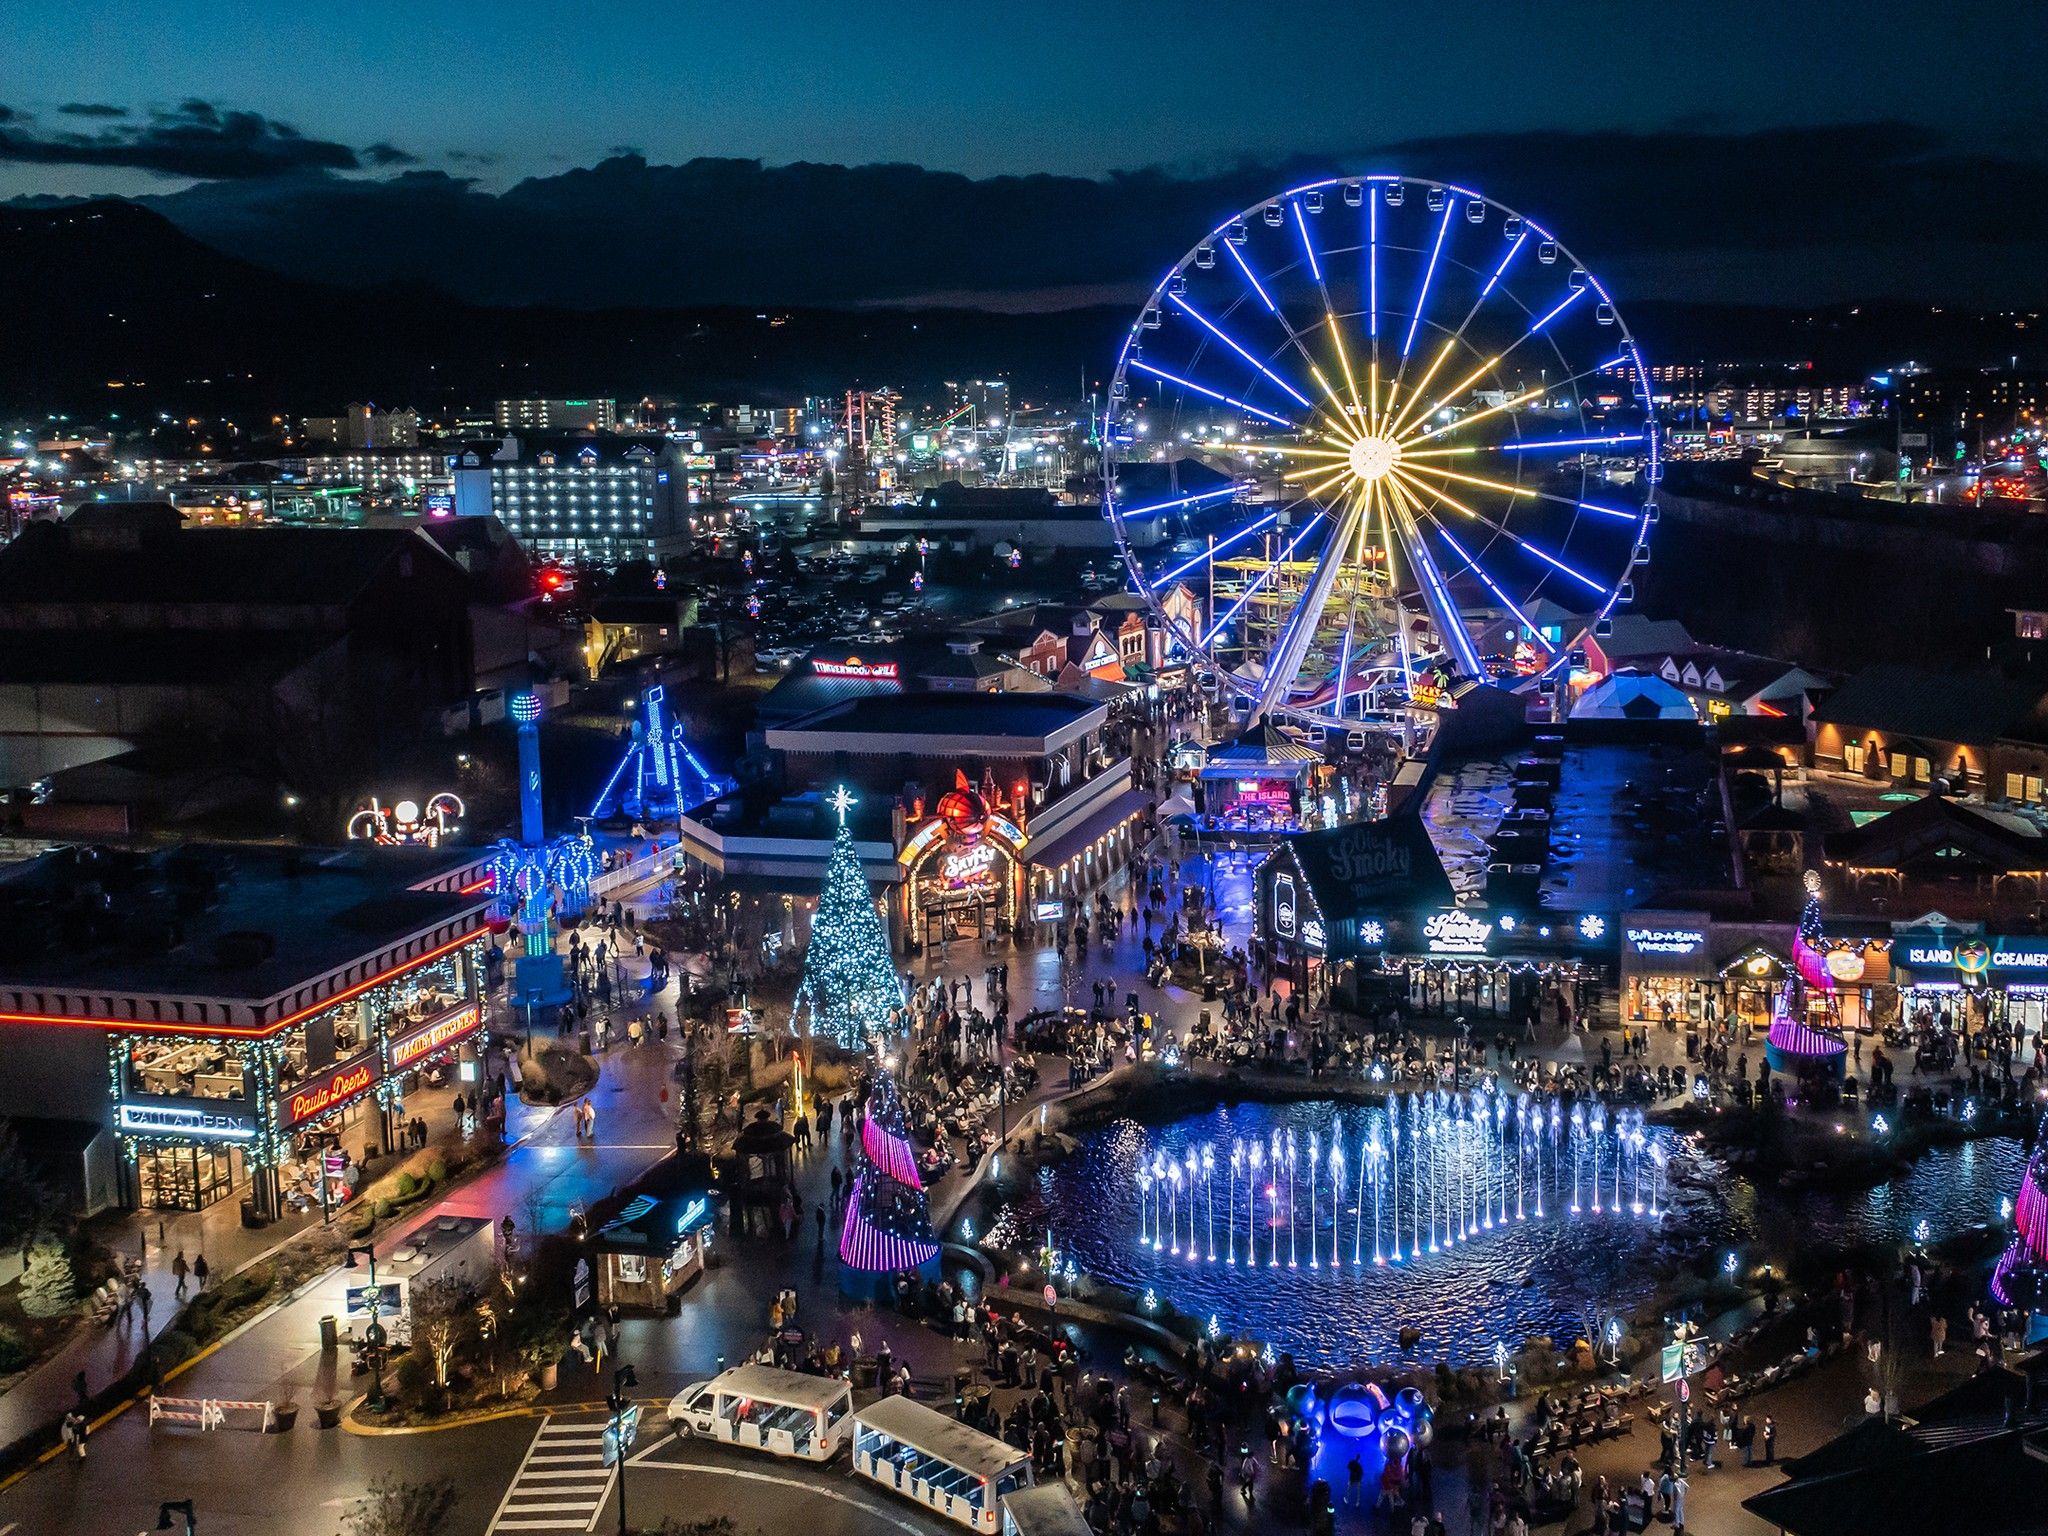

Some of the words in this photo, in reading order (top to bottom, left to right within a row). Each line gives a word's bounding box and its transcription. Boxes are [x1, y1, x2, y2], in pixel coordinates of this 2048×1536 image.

[812, 661, 869, 676] TIMBERWOOD
[872, 664, 898, 677] GRILL
[1412, 684, 1441, 698] DICK'S
[1239, 791, 1256, 802] THE
[1258, 790, 1290, 801] ISLAND
[1328, 837, 1411, 881] Smoky
[1909, 948, 1953, 963] ISLAND
[1992, 952, 2048, 967] CREAMER
[394, 1034, 433, 1065] FAMILY
[431, 1009, 478, 1043] KITCHEN
[293, 1085, 330, 1120] Paula
[331, 1066, 371, 1101] Deen's
[190, 1113, 243, 1130] DEEN
